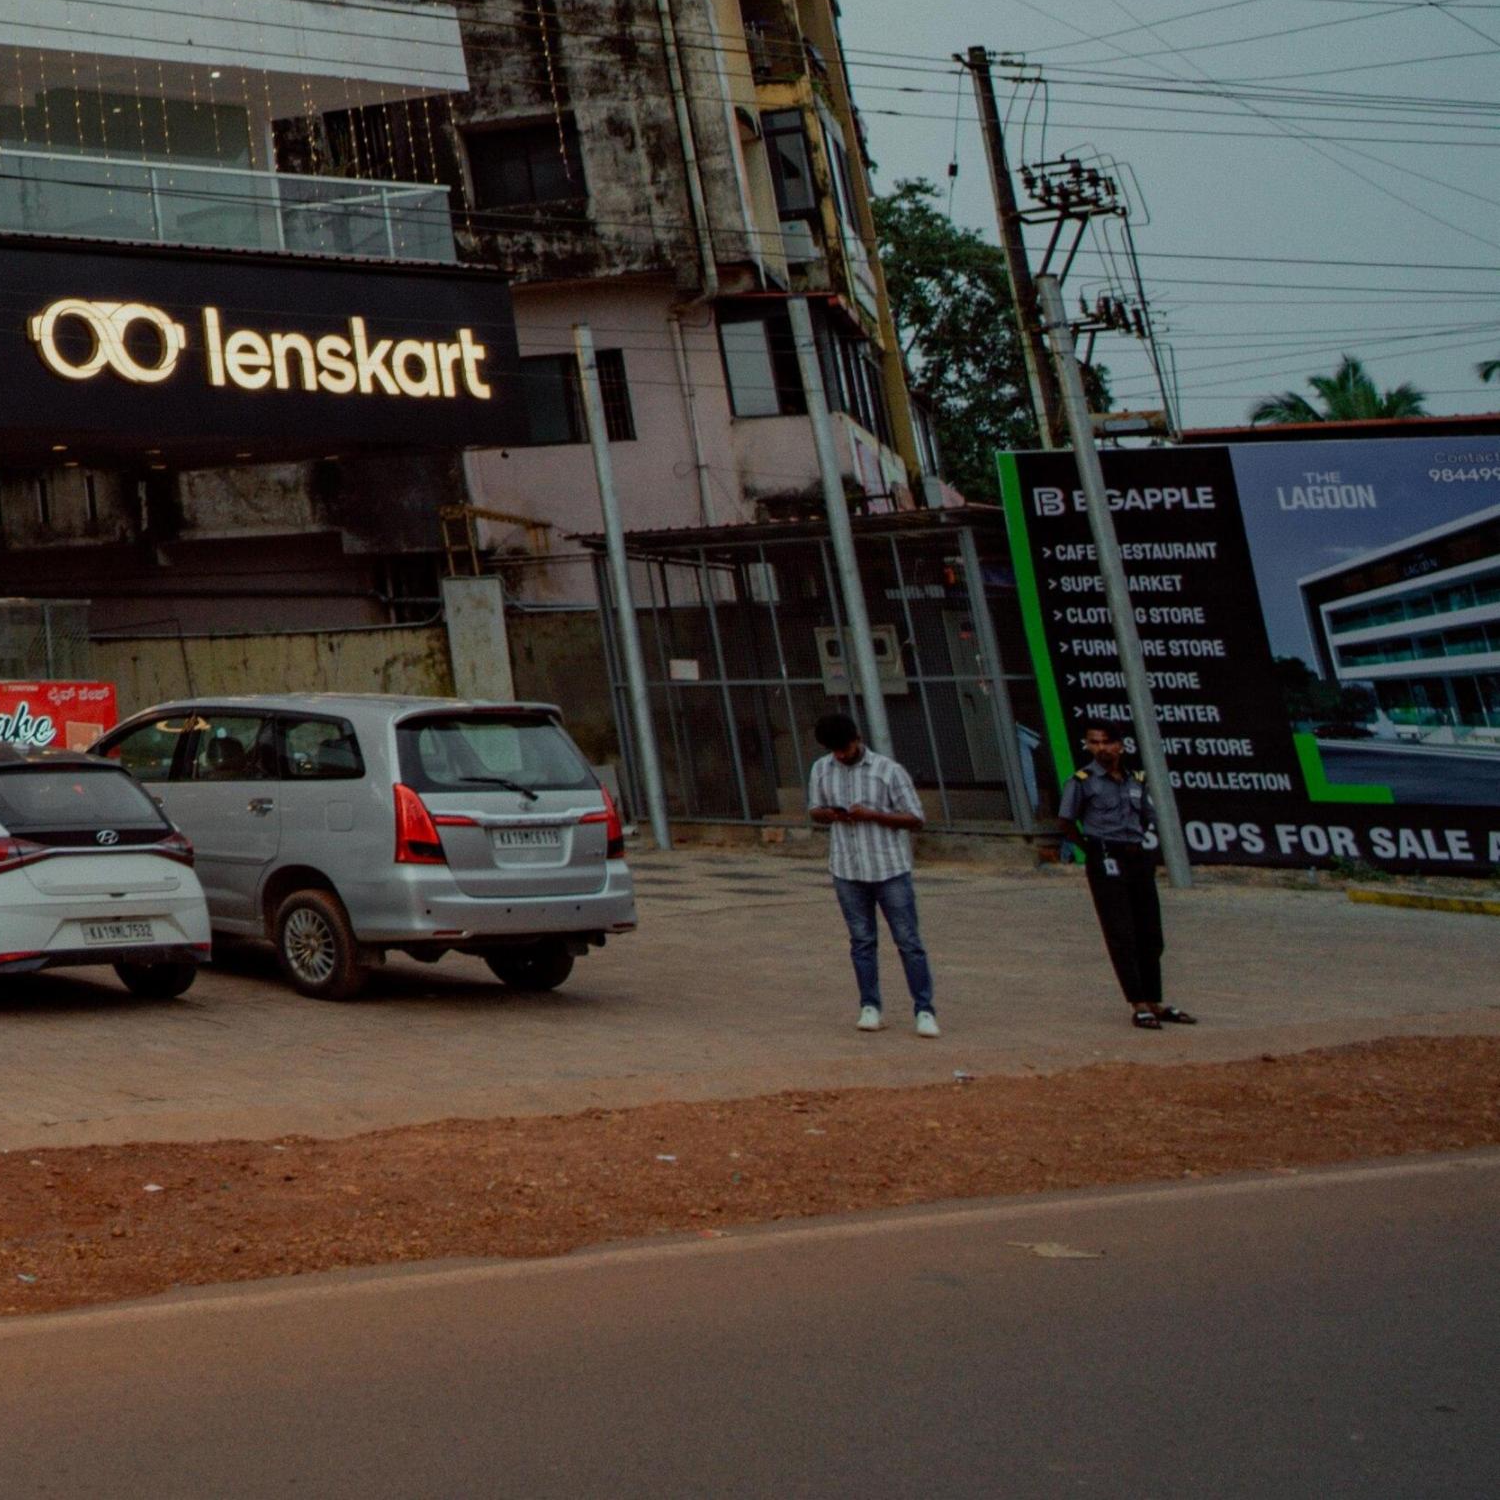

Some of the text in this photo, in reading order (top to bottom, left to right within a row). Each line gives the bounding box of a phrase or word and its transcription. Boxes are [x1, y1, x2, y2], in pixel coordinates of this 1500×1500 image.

[201, 305, 493, 401] lenskart
[1302, 471, 1342, 484] THE
[1072, 486, 1217, 513] BGAPPLE
[1276, 484, 1378, 511] LAGOON
[1055, 543, 1097, 561] CAFE
[1149, 607, 1206, 624] STORE
[1168, 639, 1226, 657] STORE
[1149, 672, 1201, 690] STORE
[1086, 703, 1221, 723] HEALT CENTER
[1195, 738, 1254, 757] STORE
[1183, 771, 1292, 791] COLLECTION
[1141, 820, 1265, 853] SOPS
[1274, 823, 1361, 857] FOR
[1369, 826, 1475, 861] SALE
